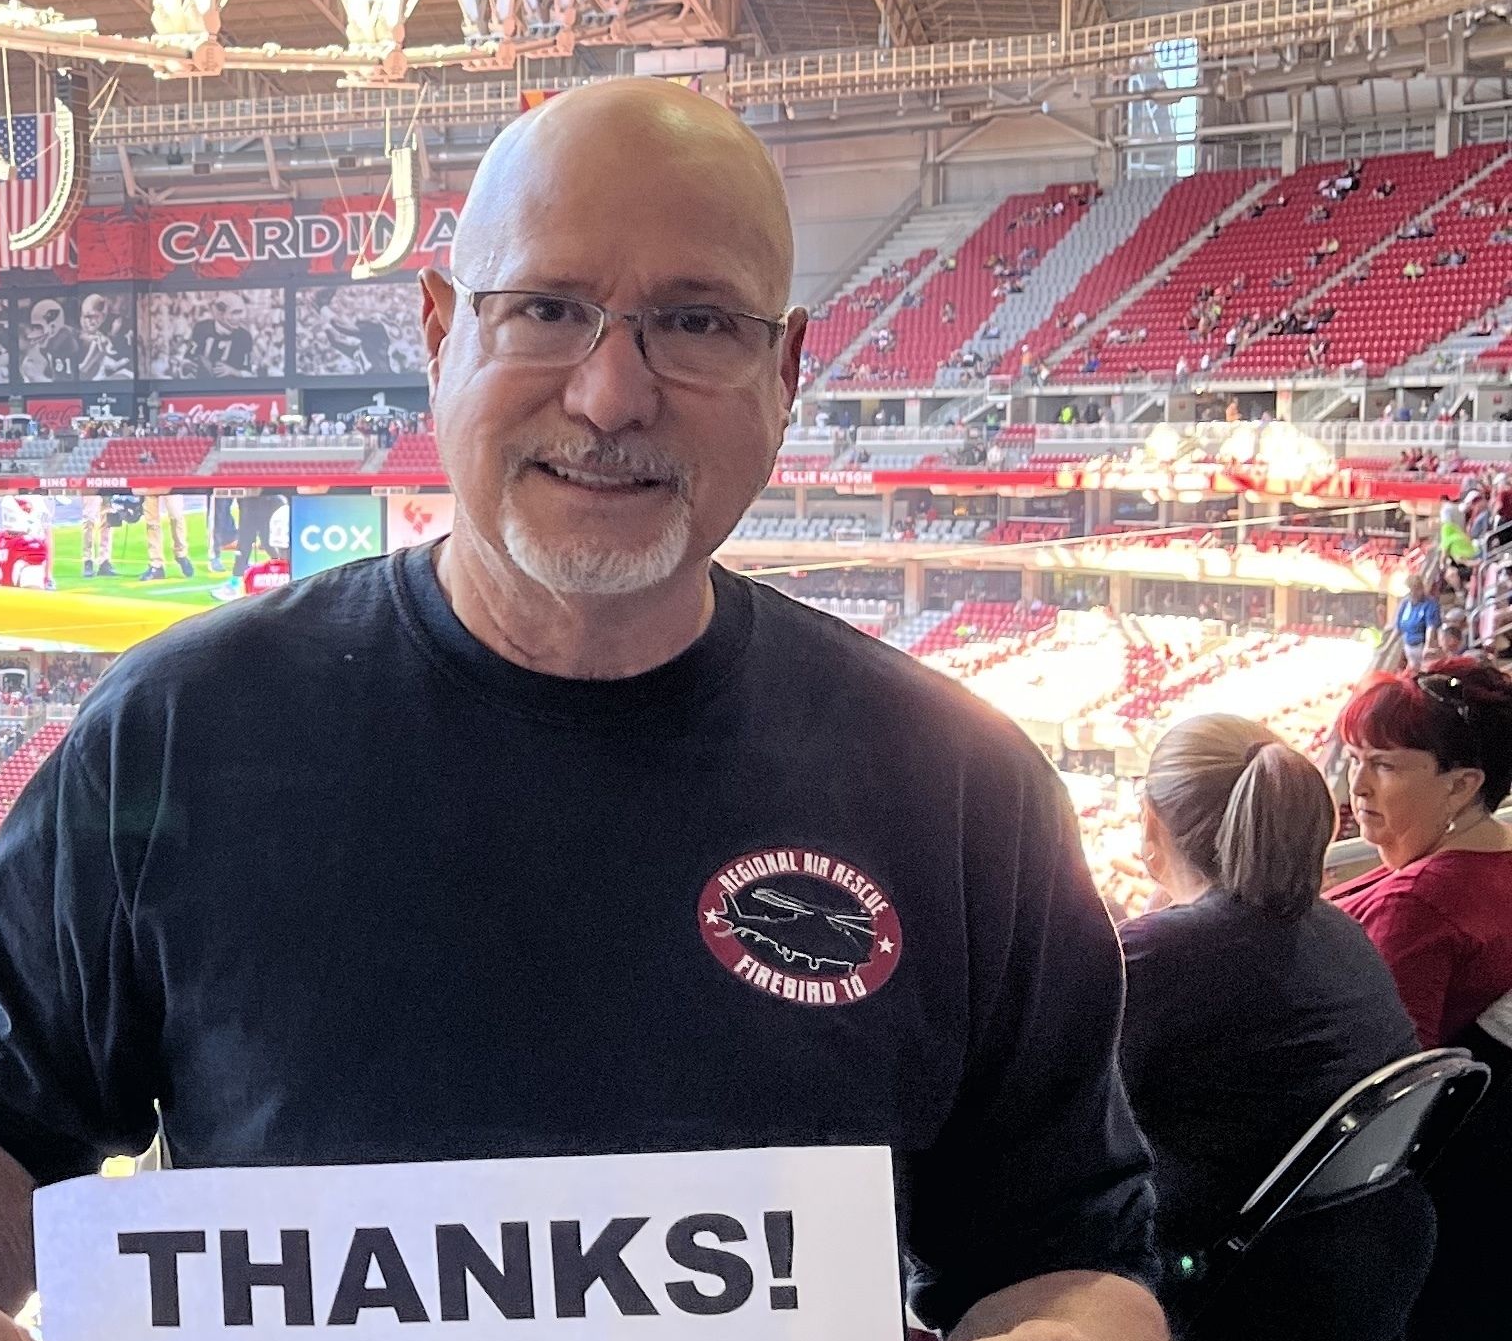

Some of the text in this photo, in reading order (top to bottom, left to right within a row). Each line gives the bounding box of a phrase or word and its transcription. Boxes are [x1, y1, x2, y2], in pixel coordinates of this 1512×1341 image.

[40, 478, 128, 488] RING OF HONOR
[781, 471, 873, 484] OLLIE MATSON
[299, 525, 373, 553] COX
[718, 851, 889, 916] REGIONAL AIR RESCUE
[734, 954, 837, 1004] FIREBIRD
[118, 1211, 800, 1327] THANKS!
